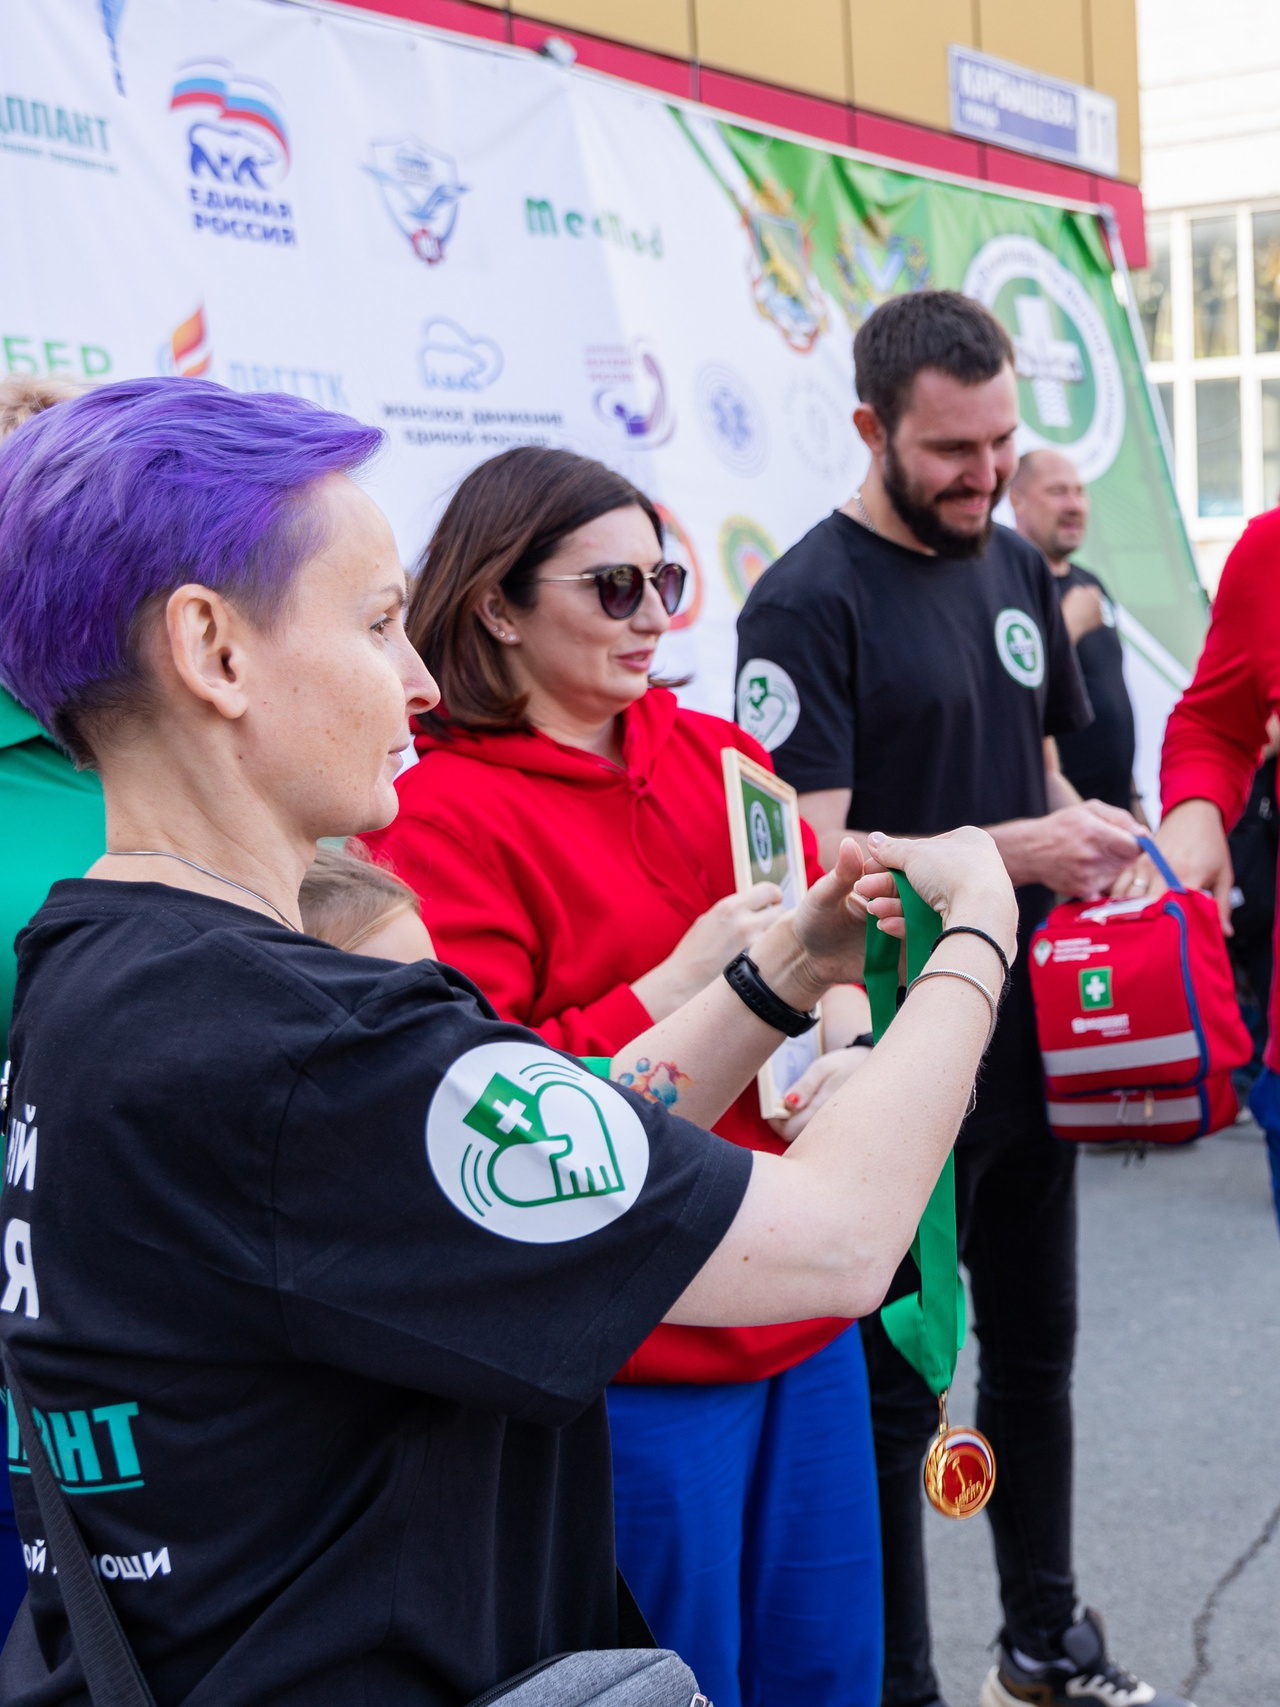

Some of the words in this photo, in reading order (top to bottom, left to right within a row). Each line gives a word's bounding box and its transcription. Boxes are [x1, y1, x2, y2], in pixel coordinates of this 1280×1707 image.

[0, 95, 109, 154] ПЛАНТ
[189, 187, 293, 219] ЕДИНАЯ
[194, 213, 297, 246] РОССИЯ
